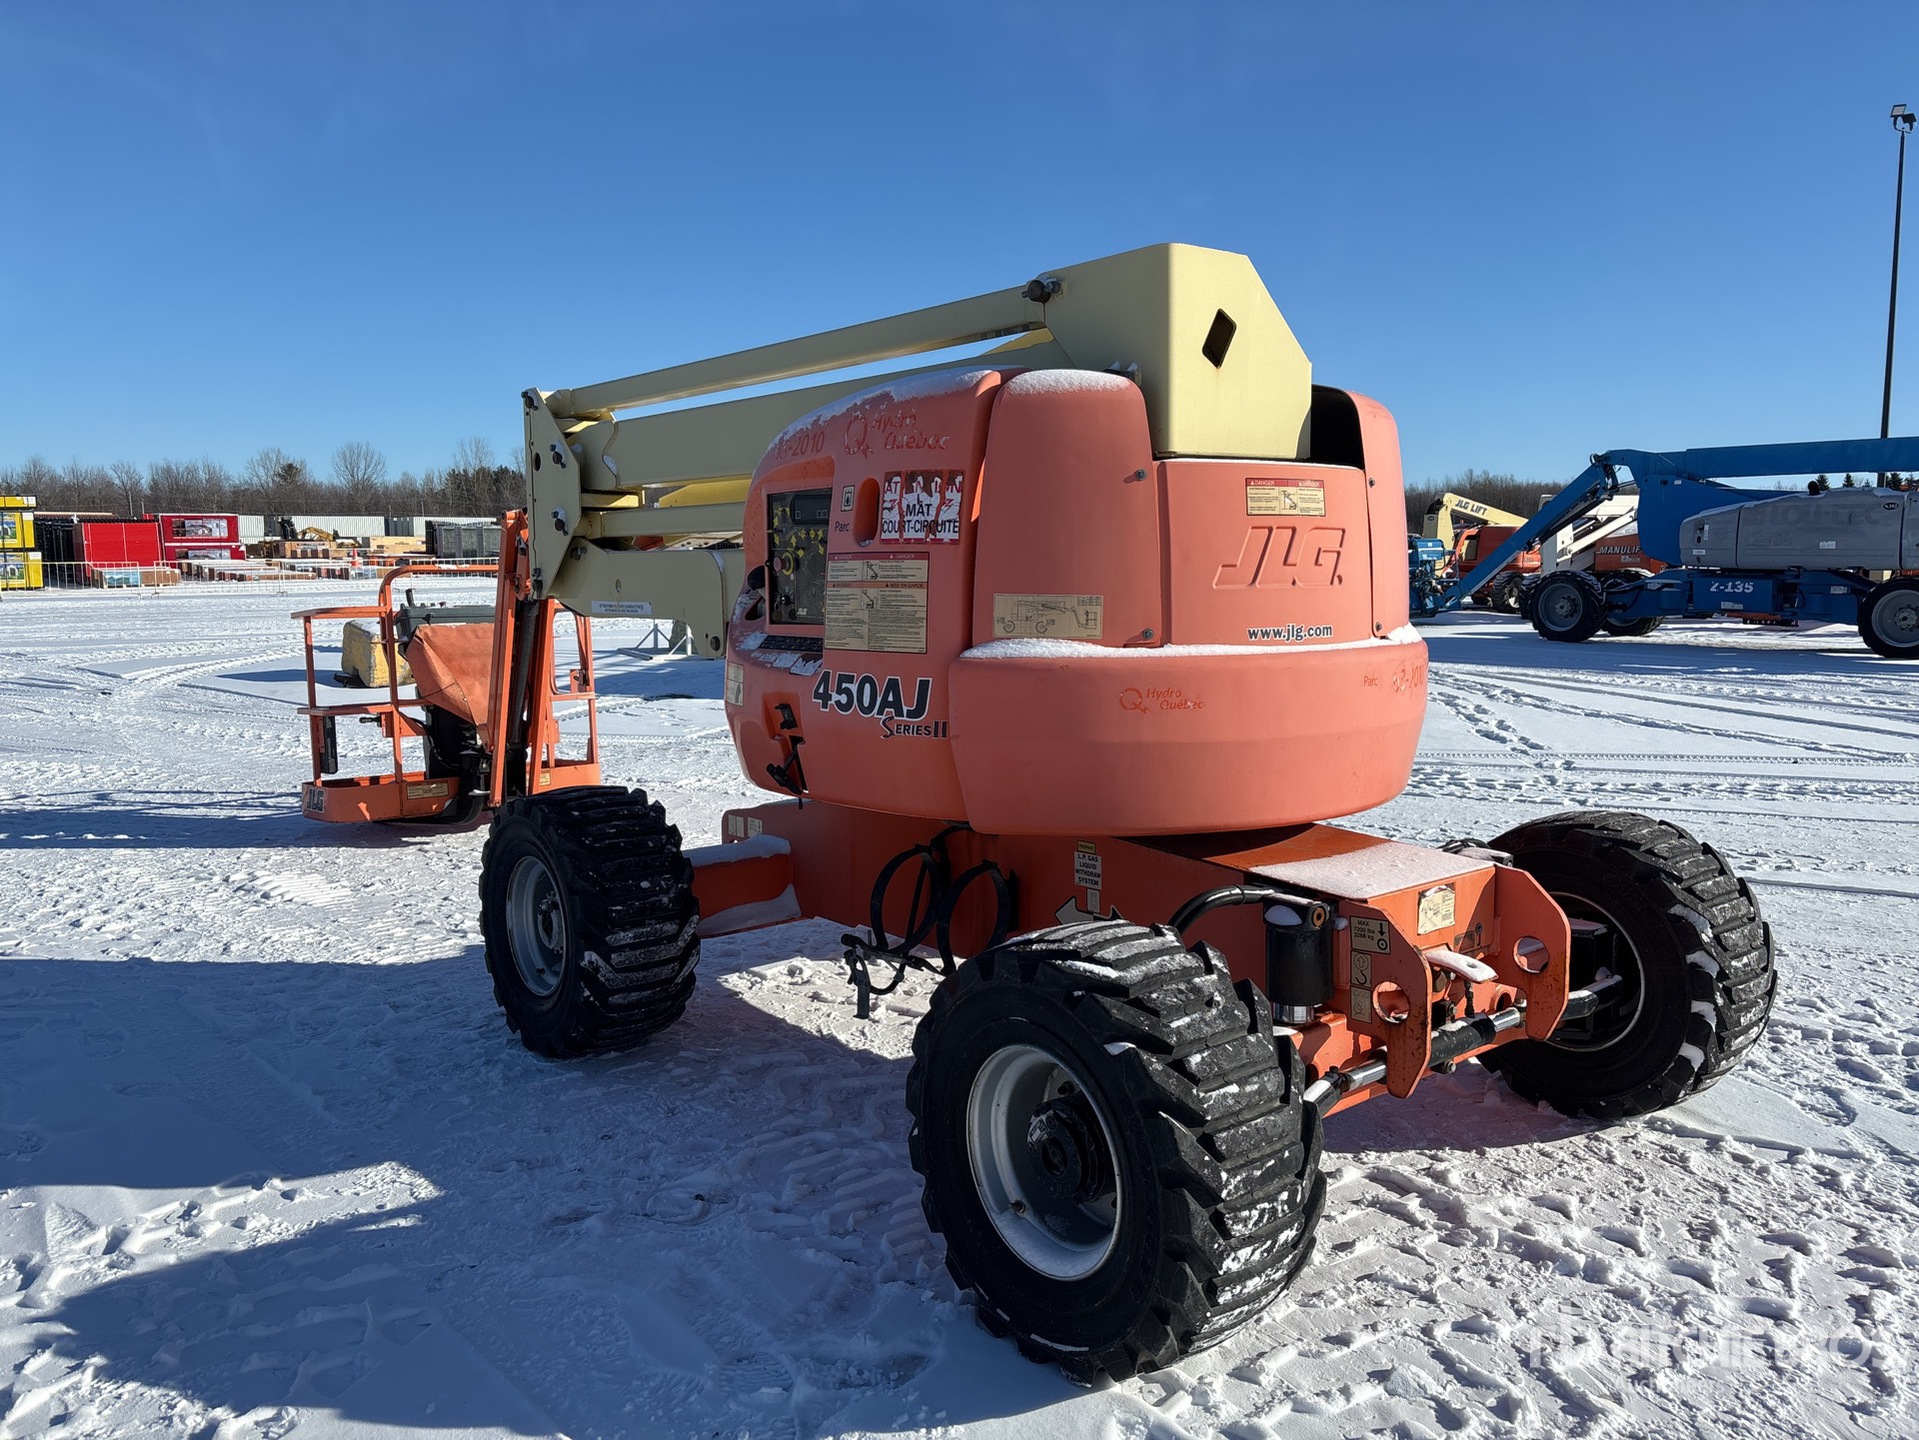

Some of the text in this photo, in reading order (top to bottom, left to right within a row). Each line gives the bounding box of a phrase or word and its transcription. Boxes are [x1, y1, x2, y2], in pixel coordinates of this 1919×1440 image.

[905, 501, 933, 517] MÂT
[1455, 499, 1488, 516] JLG LIFT
[834, 521, 850, 532] Parc
[1213, 526, 1345, 589] JLG
[1599, 545, 1642, 555] MANULIF
[1247, 624, 1333, 642] www.jlg.com
[1363, 675, 1379, 687] Parc
[812, 669, 932, 721] 450AJ
[1146, 687, 1182, 700] Hydro
[1160, 698, 1204, 710] Québec
[306, 788, 324, 812] JLG
